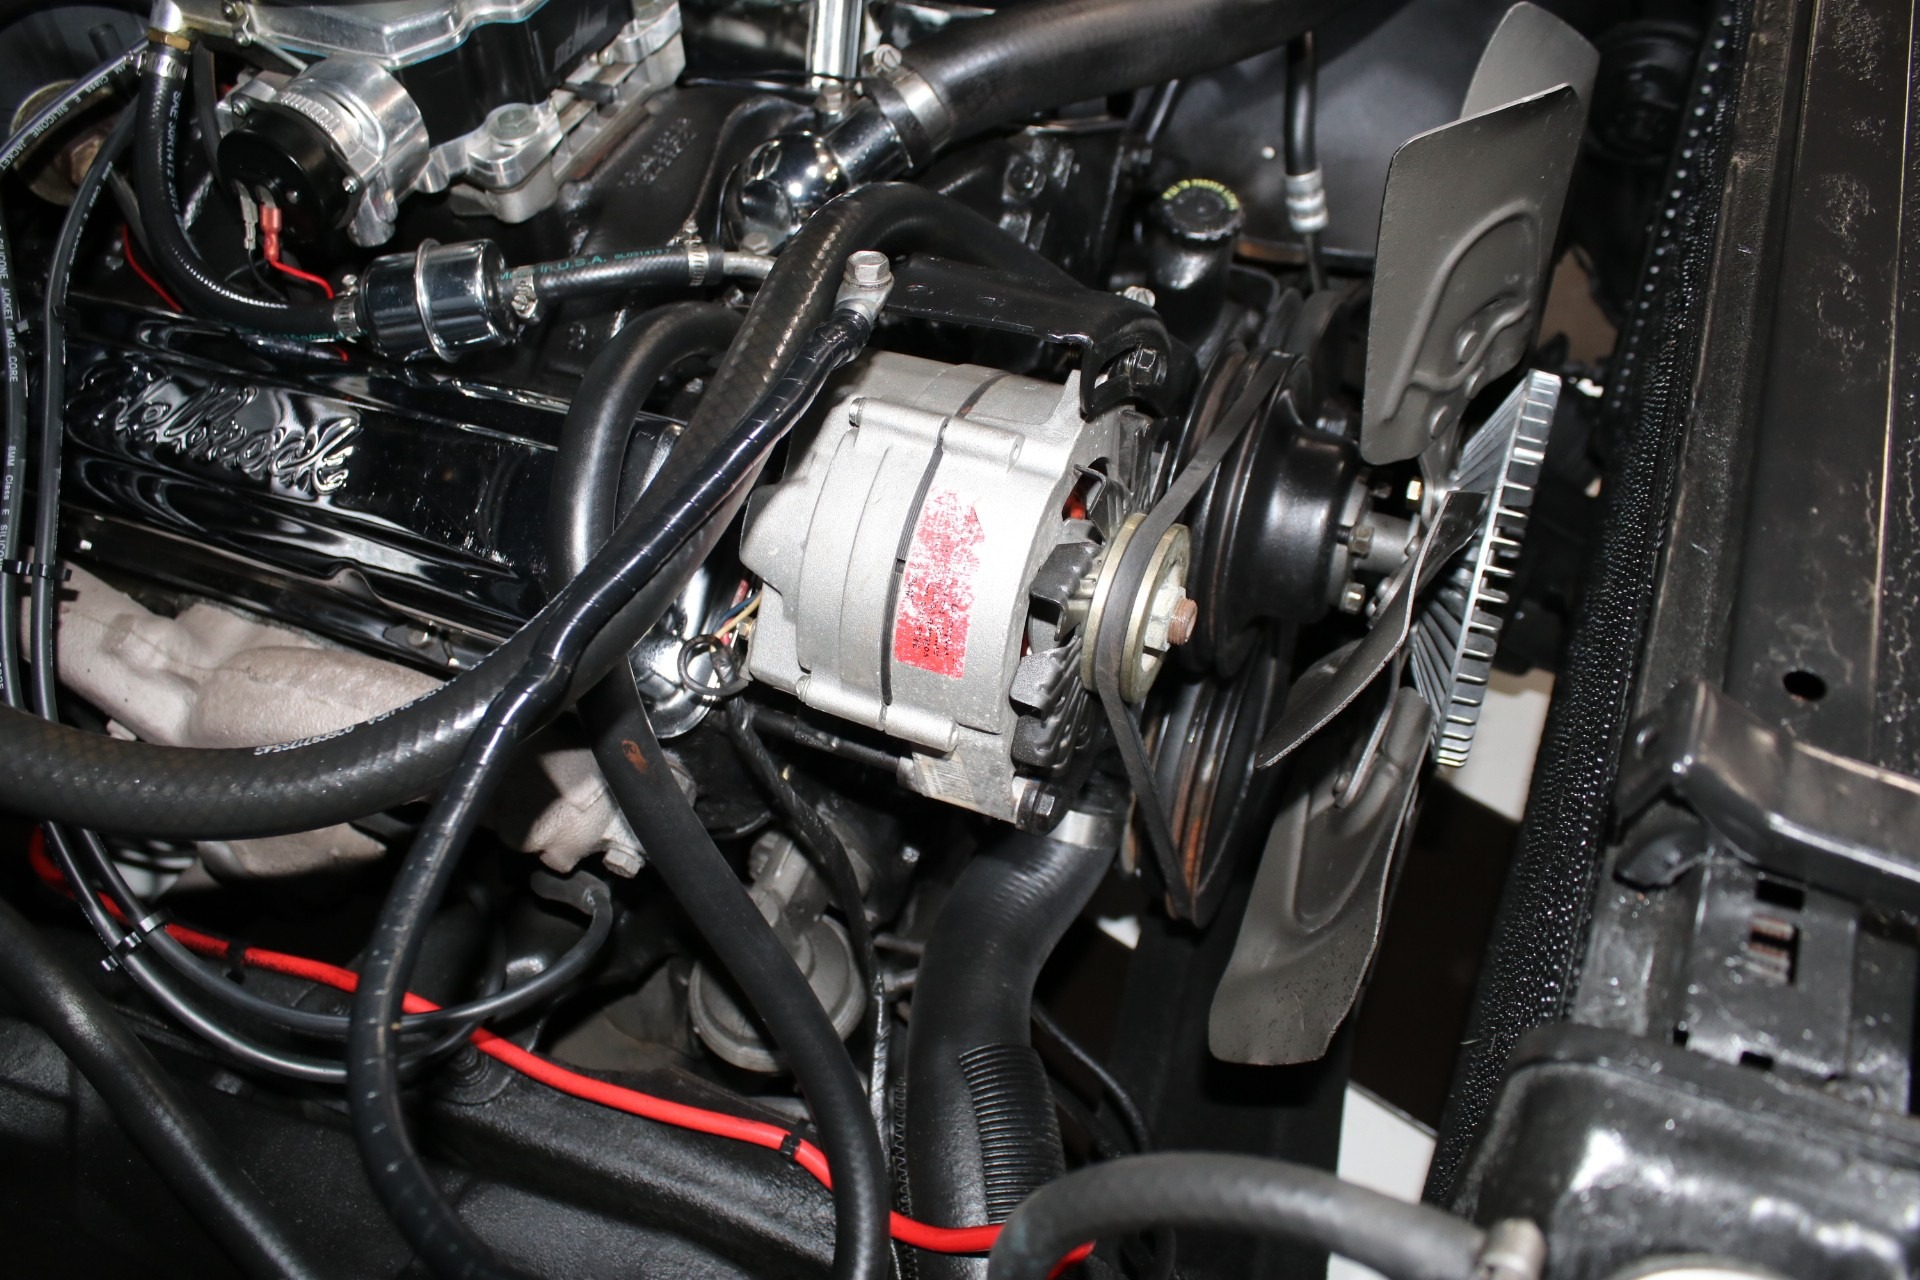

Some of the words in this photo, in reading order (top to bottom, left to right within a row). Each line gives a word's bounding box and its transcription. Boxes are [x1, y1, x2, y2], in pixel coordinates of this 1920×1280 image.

[85, 76, 109, 94] Class
[73, 95, 82, 104] E
[169, 91, 181, 119] SAE
[32, 104, 69, 138] SILICONE
[0, 139, 27, 171] JACKET
[1, 287, 14, 321] JACKET
[6, 327, 17, 349] MAG
[8, 356, 19, 383] CORE
[7, 445, 17, 467] 8MM
[3, 474, 14, 501] Class
[1, 508, 10, 516] E
